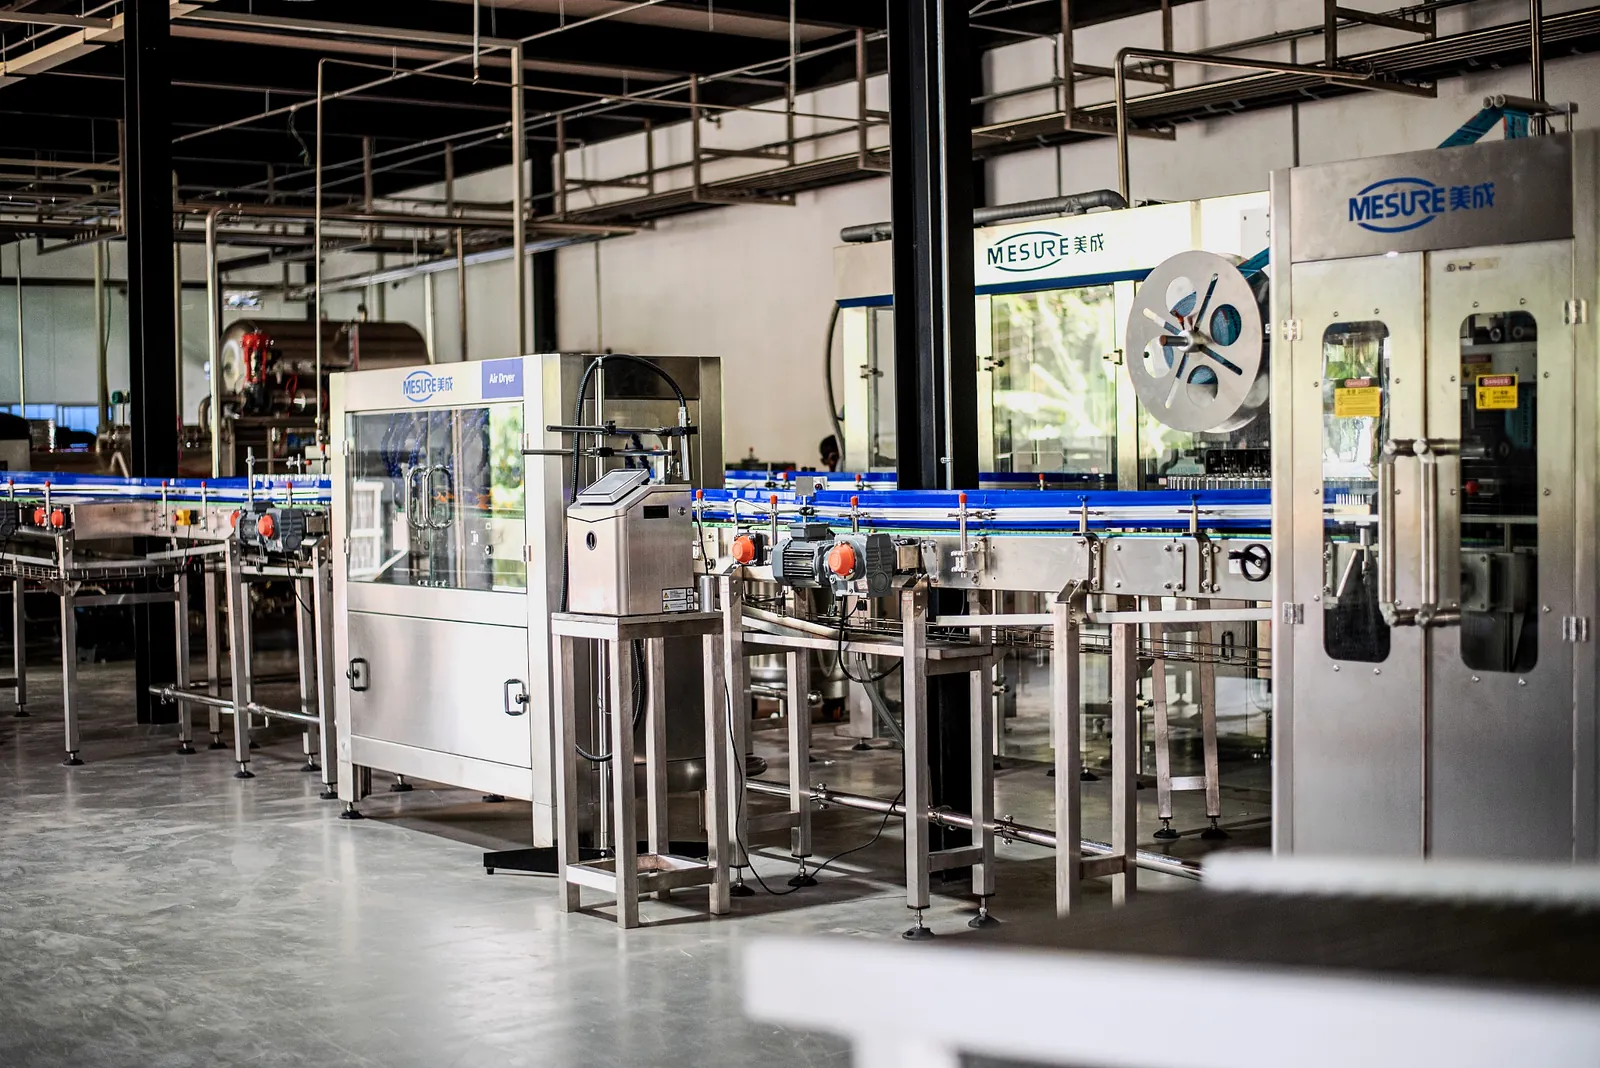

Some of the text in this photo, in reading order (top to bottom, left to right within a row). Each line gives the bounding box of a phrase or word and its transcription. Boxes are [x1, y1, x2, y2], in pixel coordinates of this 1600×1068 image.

[1348, 181, 1495, 221] MESURE 美成
[987, 233, 1104, 265] MESURE 美成
[403, 376, 453, 395] MESURE 美成
[489, 372, 515, 385] Air Dryer
